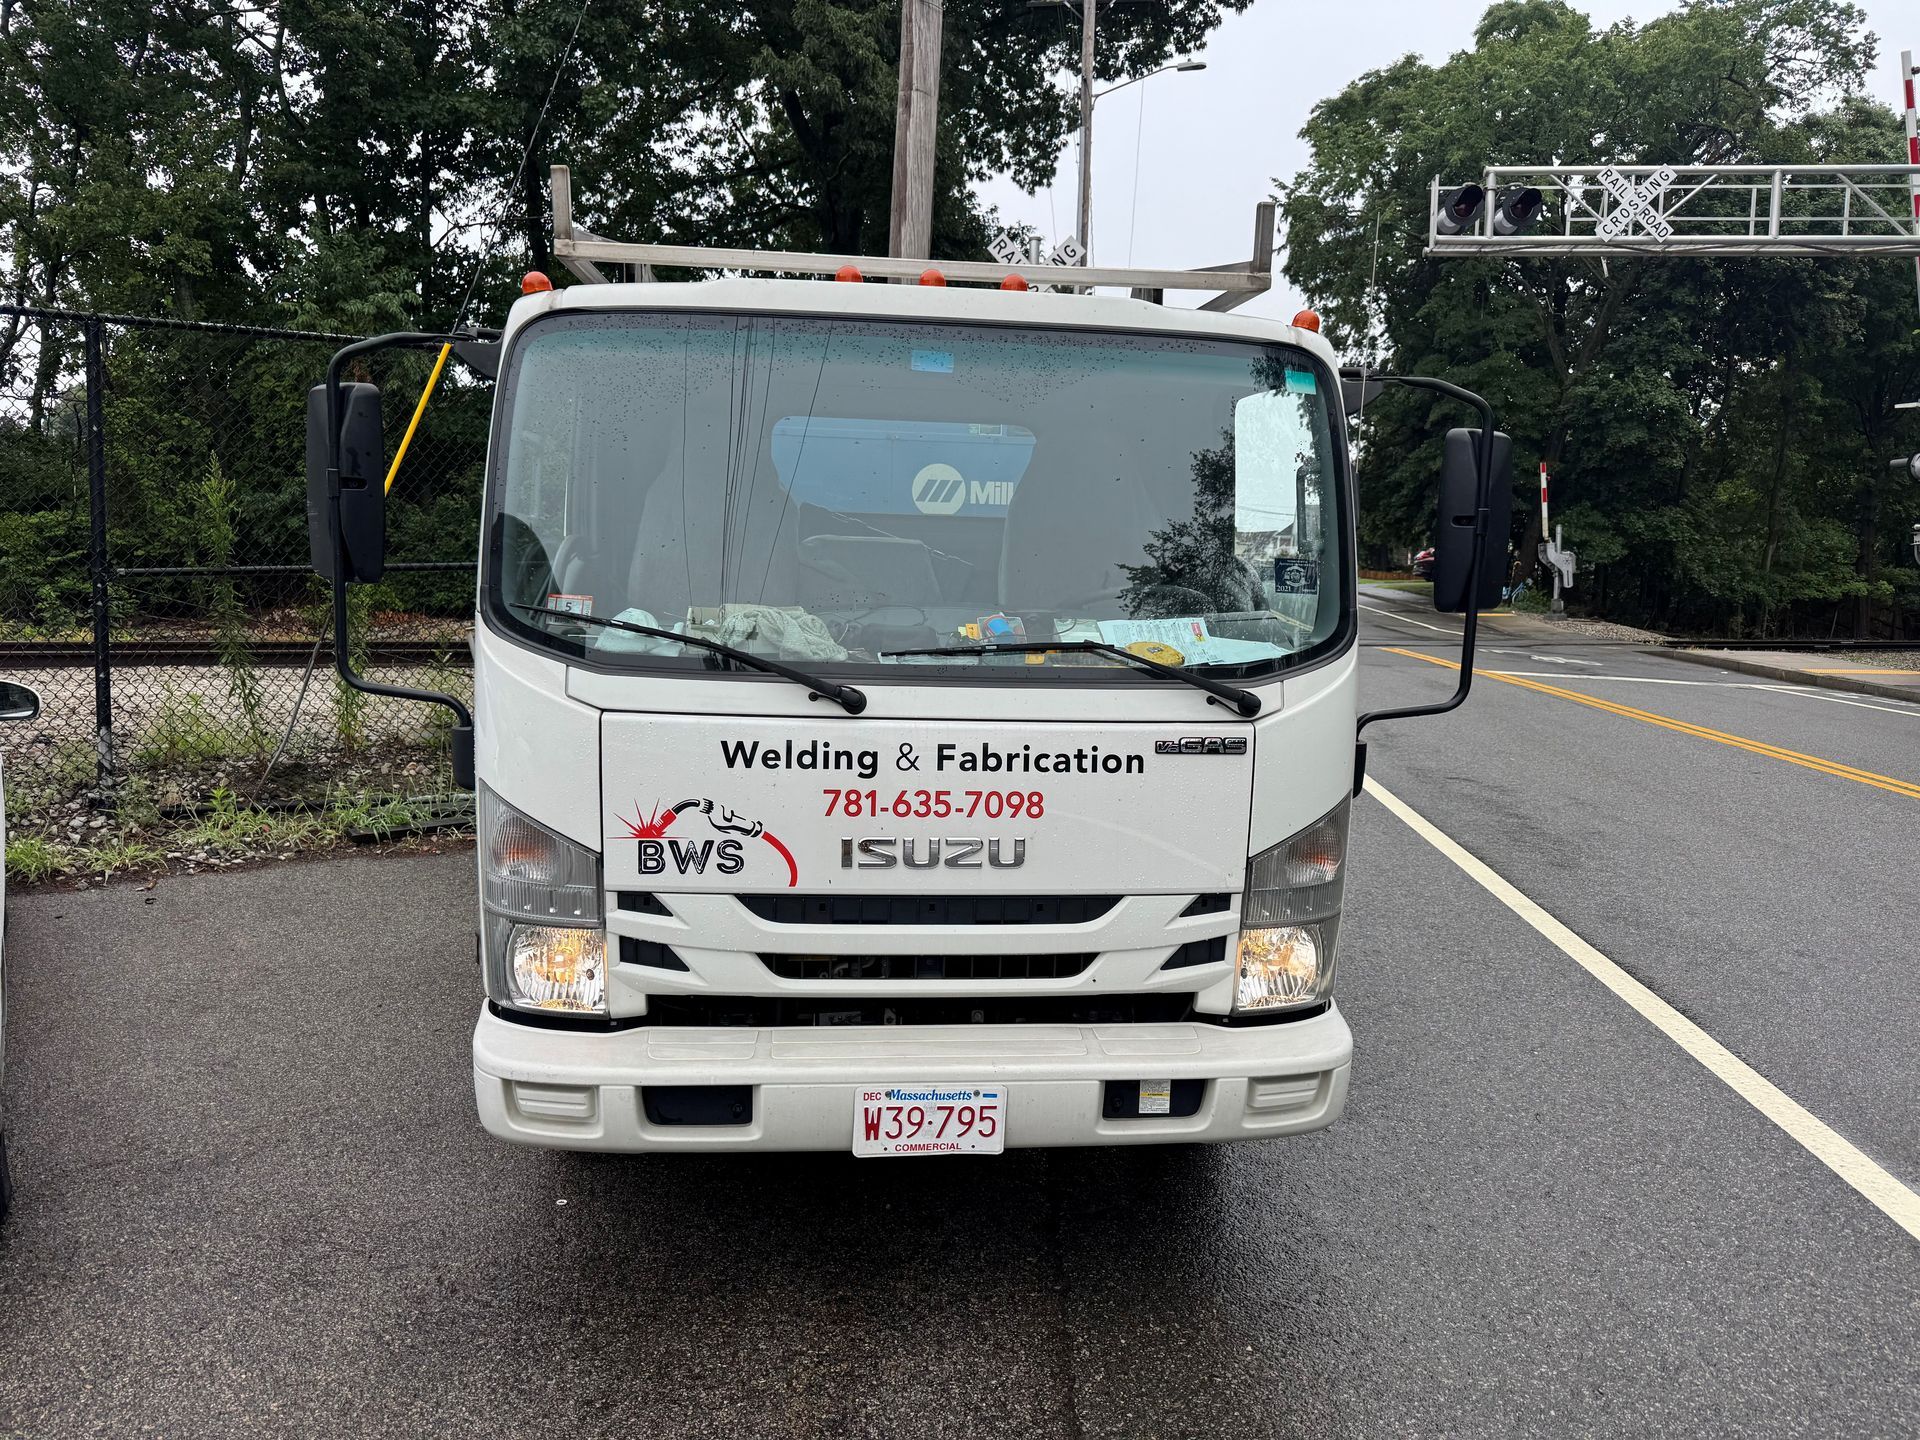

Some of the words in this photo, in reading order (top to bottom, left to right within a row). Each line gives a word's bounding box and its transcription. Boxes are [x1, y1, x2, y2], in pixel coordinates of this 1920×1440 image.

[1601, 169, 1628, 199] RAIL
[1602, 171, 1670, 235] CROSSING
[1639, 207, 1669, 238] ROAD
[993, 238, 1025, 265] RAI
[565, 601, 572, 612] 5
[720, 739, 879, 779] Welding
[895, 742, 920, 771] &
[936, 742, 1144, 774] Fabrication
[823, 788, 1044, 819] 781-635-7098
[638, 839, 745, 875] BWS
[841, 836, 1026, 869] ISUZU
[863, 1092, 882, 1101] DEC
[889, 1089, 973, 1101] Massachusetts
[895, 1142, 962, 1152] COMMERCIAL
